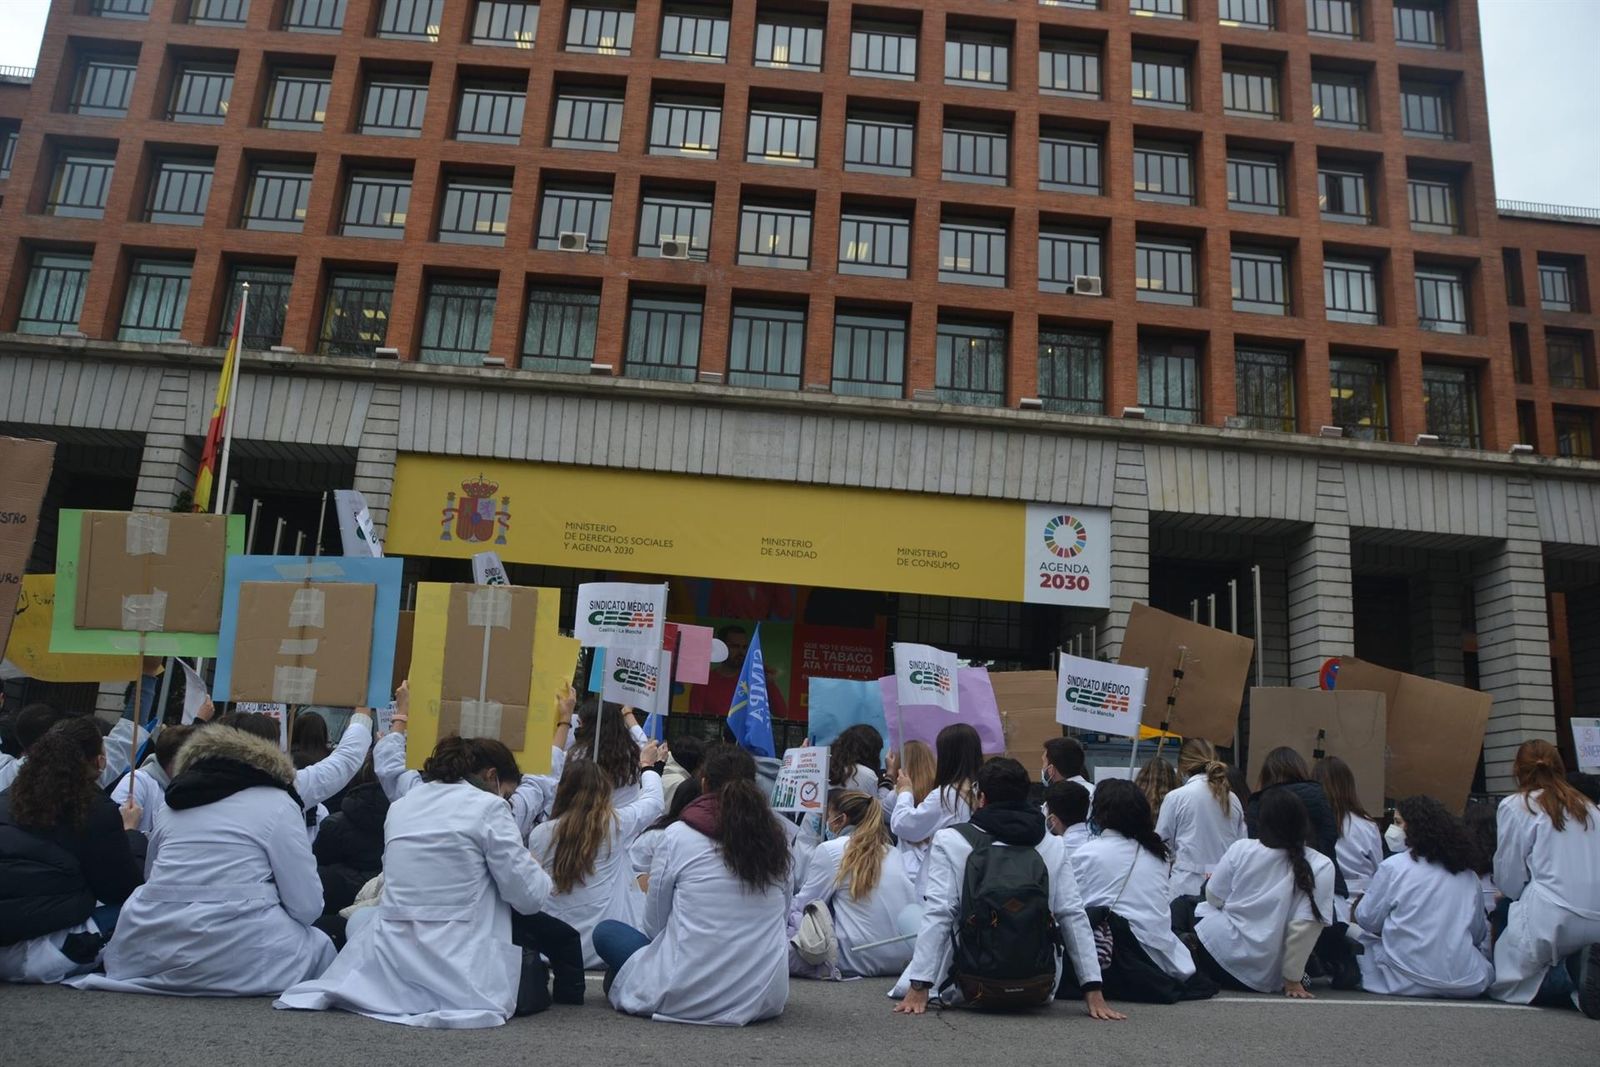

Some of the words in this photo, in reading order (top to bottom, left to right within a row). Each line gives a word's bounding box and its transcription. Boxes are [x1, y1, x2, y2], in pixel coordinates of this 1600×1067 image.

[565, 521, 617, 533] MINISTERIO
[564, 531, 577, 541] DE
[579, 533, 629, 545] DERECHOS
[631, 537, 674, 548] SOCIALES
[761, 537, 813, 549] MINISTERIO
[563, 542, 570, 550] Y
[571, 543, 612, 553] AGENDA
[614, 545, 634, 555] 2030
[760, 547, 773, 557] DE
[775, 548, 818, 560] SANIDAD
[897, 547, 948, 559] MINISTERIO
[896, 557, 909, 567] DE
[911, 558, 960, 570] CONSUMO
[1039, 561, 1090, 574] AGENDA
[1039, 573, 1090, 592] 2030
[589, 600, 626, 611] SINDICATO
[626, 599, 654, 612] MÉDICO
[588, 611, 654, 628] CESM
[803, 649, 819, 660] EL
[822, 650, 873, 664] TABACO
[802, 660, 821, 670] ATA
[822, 662, 831, 671] Y
[832, 662, 845, 672] TE
[847, 664, 873, 674] MATA
[1067, 674, 1100, 691] SINDICATO
[1100, 680, 1131, 696] MÉDICO
[1065, 686, 1130, 713] CESM
[1096, 709, 1115, 718] Mancha
